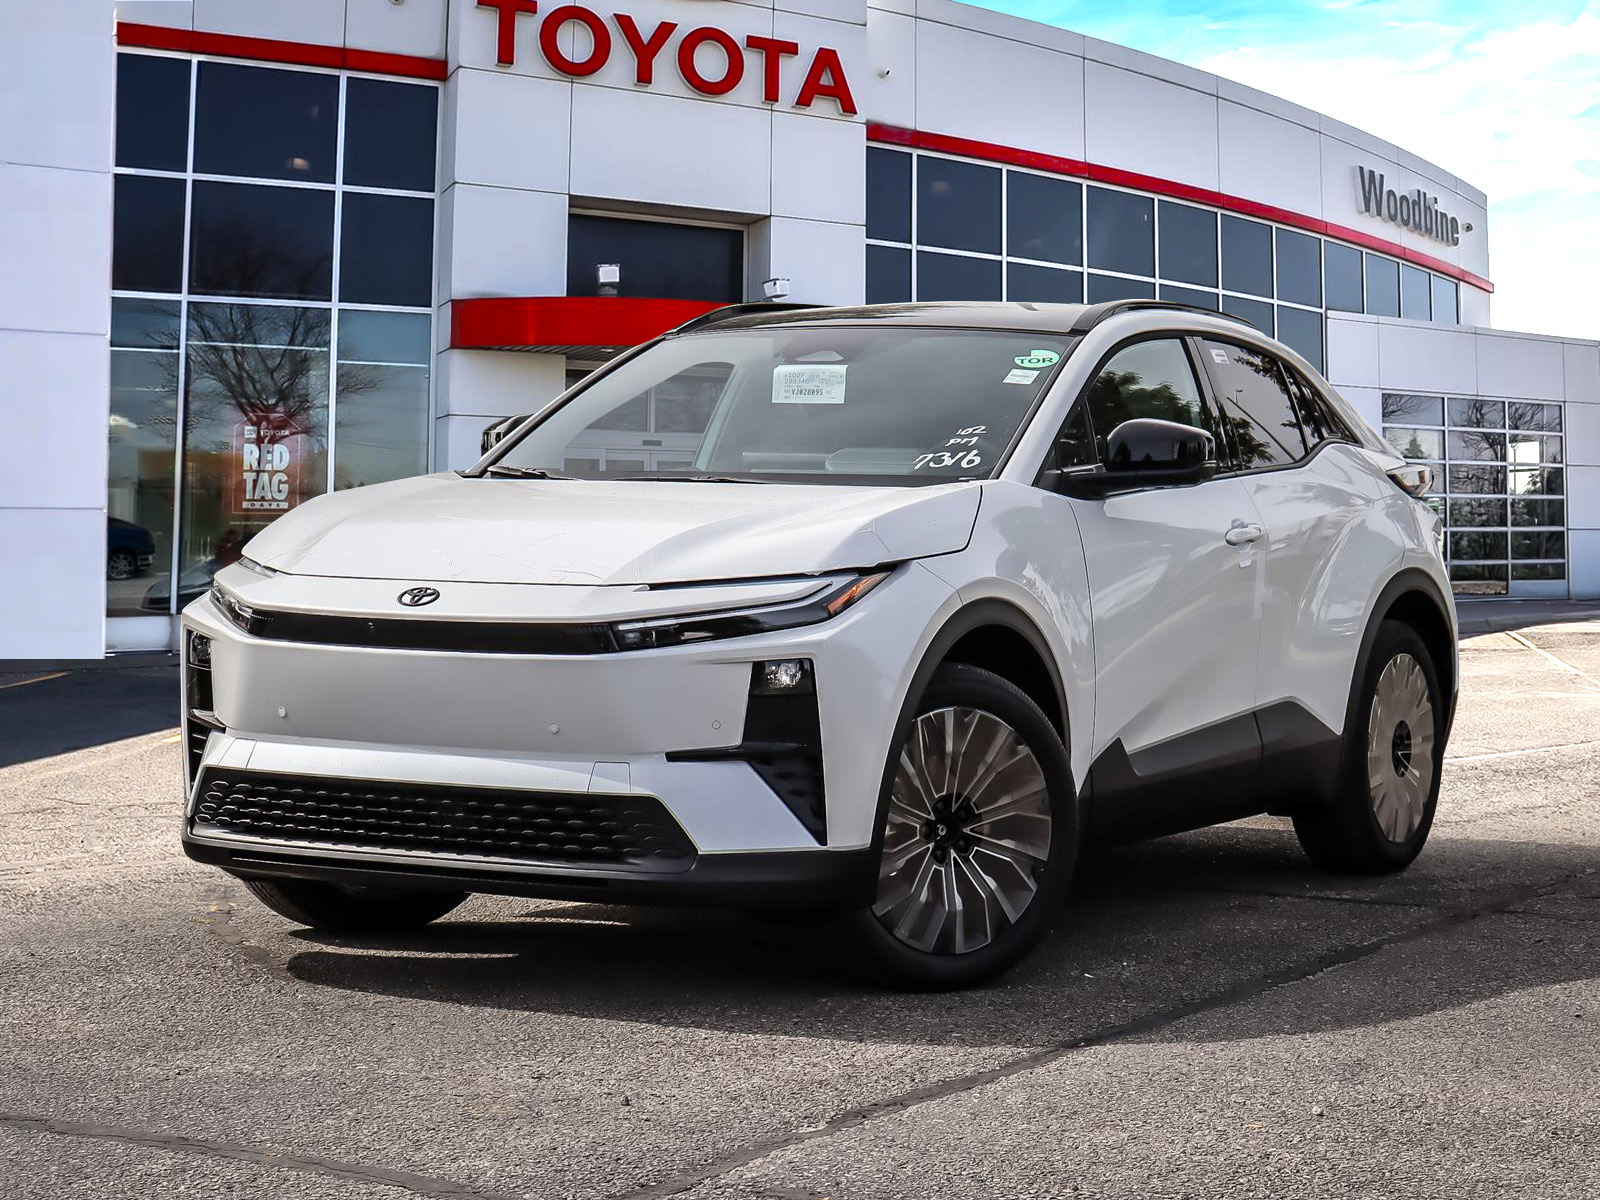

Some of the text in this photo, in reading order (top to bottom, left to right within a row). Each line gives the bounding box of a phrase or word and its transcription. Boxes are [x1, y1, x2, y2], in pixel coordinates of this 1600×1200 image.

[476, 0, 858, 116] TOYOTA
[1357, 165, 1460, 247] Woodbine
[260, 429, 290, 437] TOYOTA
[956, 425, 987, 435] 102
[243, 443, 290, 471] RED
[912, 449, 982, 470] 7316
[242, 472, 289, 500] TAG
